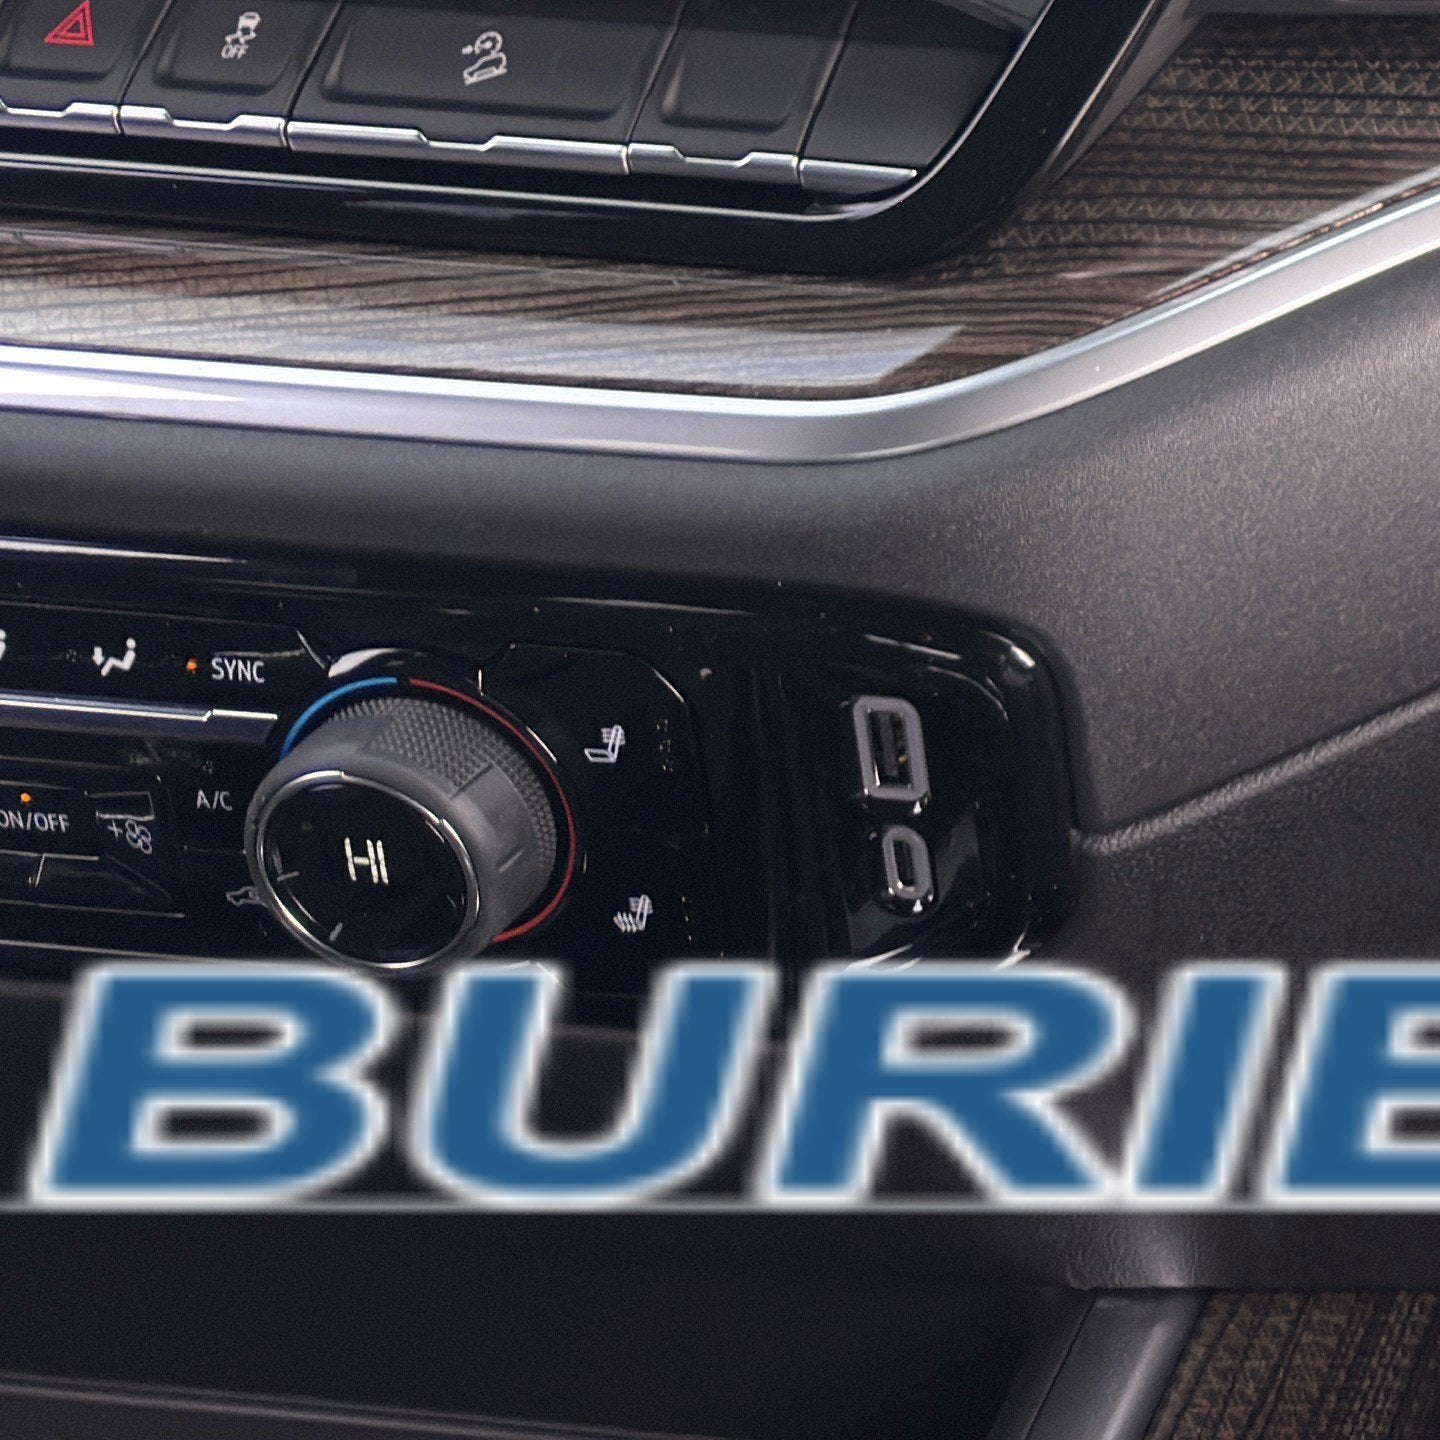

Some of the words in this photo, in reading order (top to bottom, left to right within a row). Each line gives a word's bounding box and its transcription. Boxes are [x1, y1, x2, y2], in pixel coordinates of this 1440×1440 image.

[211, 657, 266, 685] SYNC
[196, 789, 233, 811] A/C
[343, 836, 389, 885] HI
